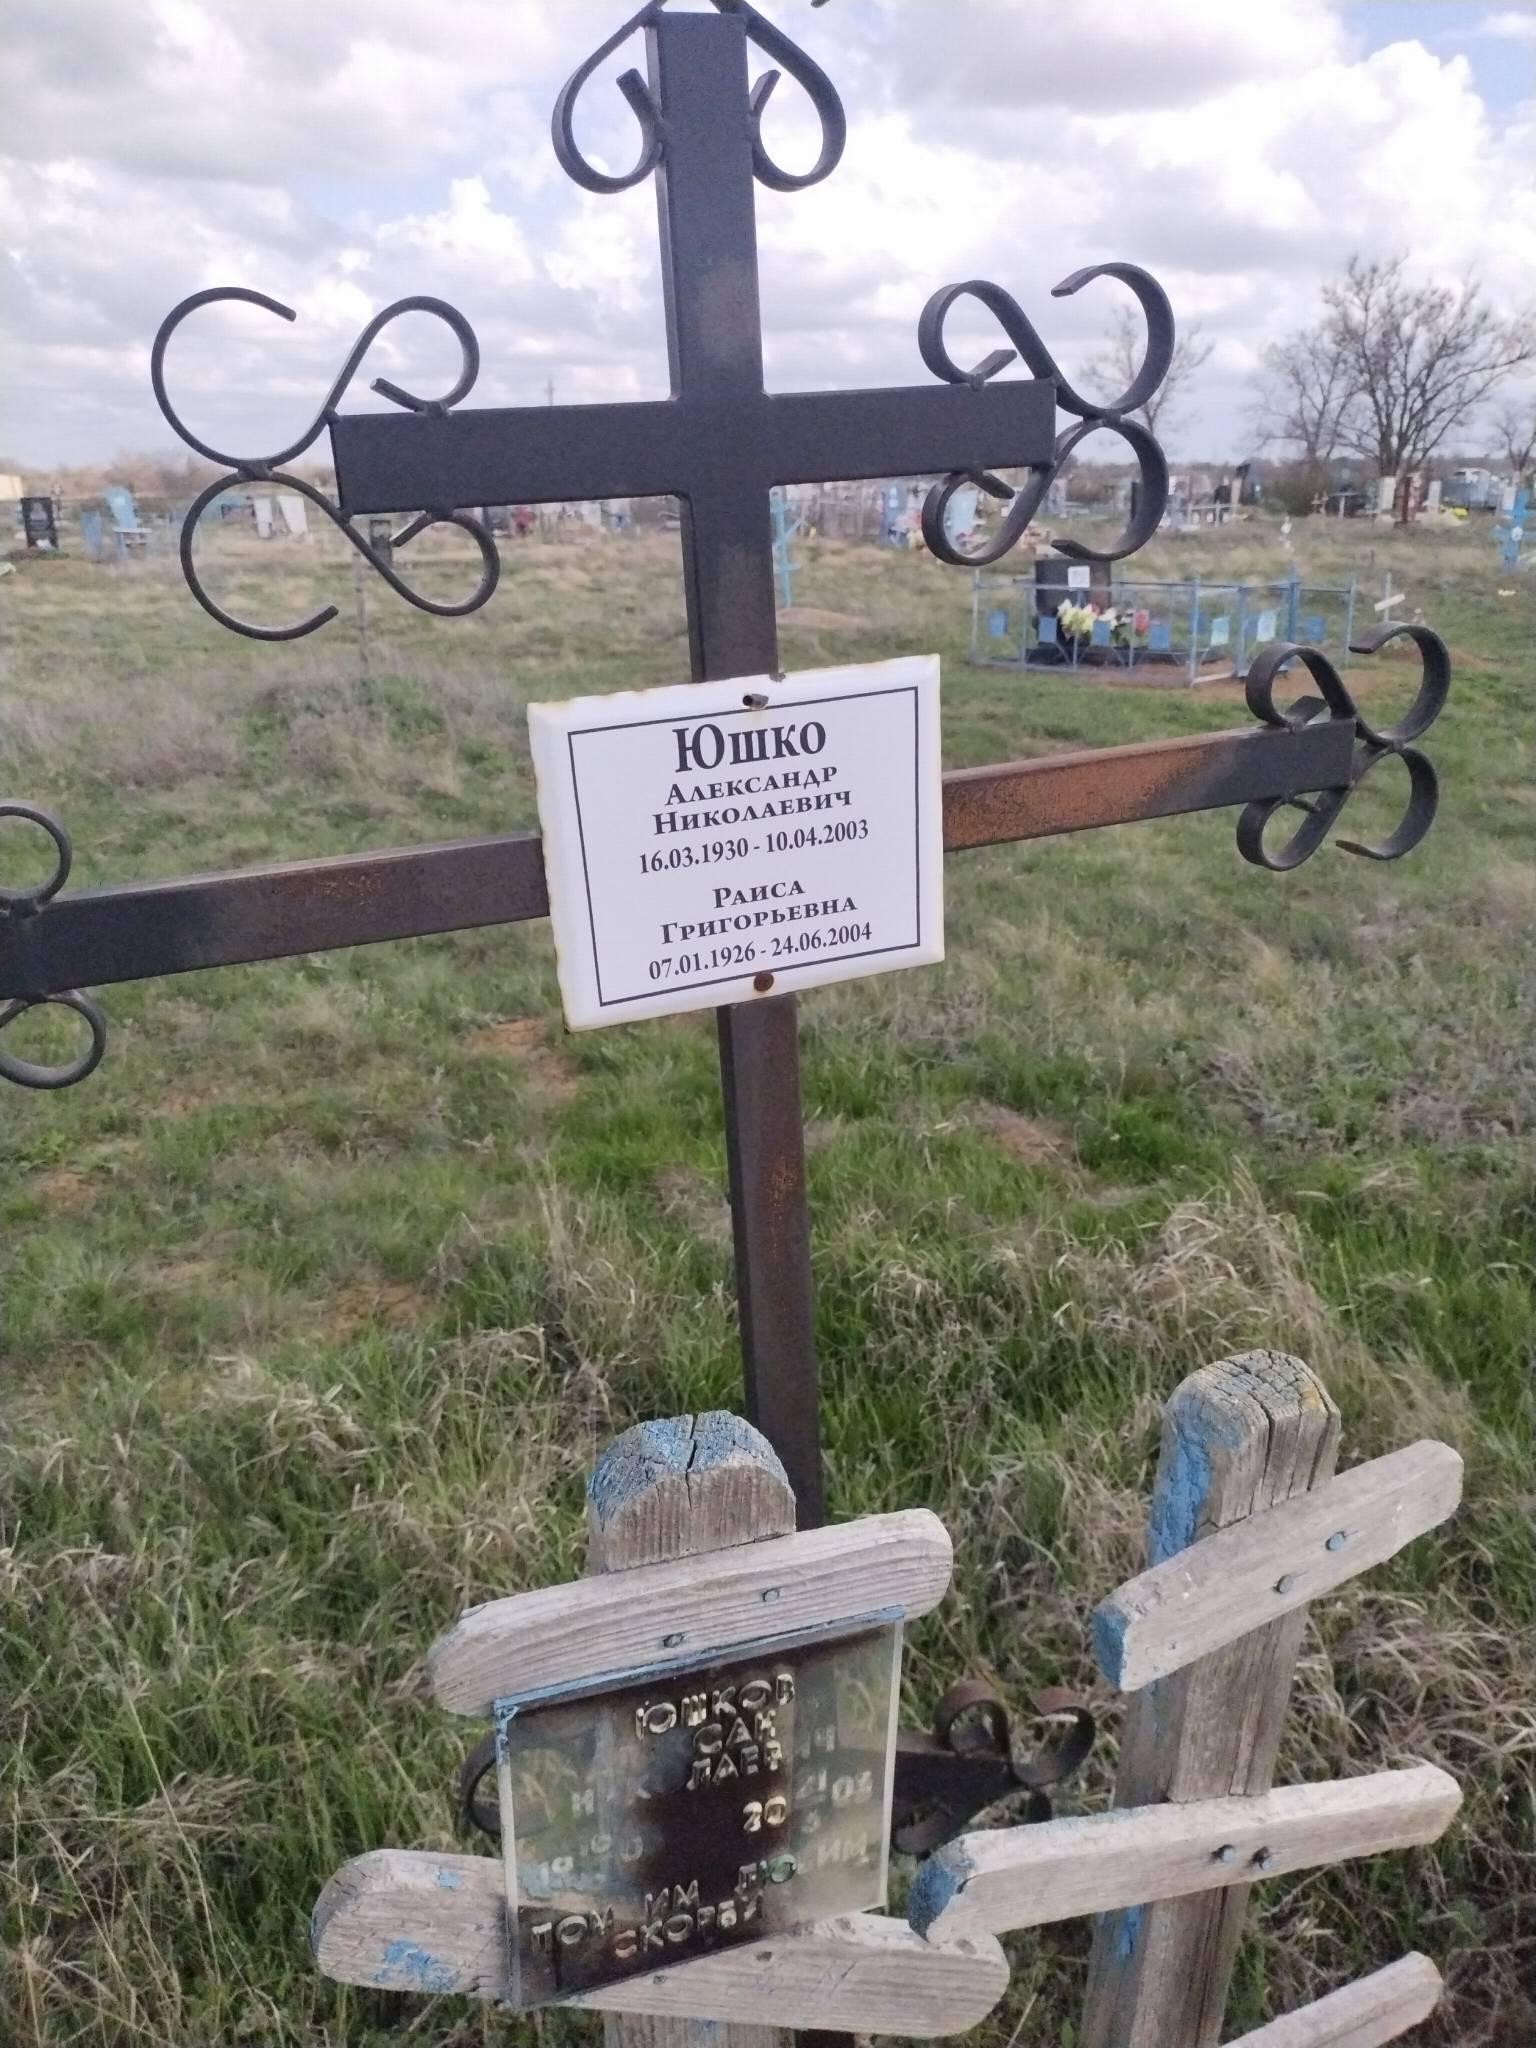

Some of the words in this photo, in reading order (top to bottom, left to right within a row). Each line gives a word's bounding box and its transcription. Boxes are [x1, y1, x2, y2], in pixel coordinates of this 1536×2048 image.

[640, 838, 749, 873] 16.03.1930
[766, 819, 869, 853] 10.04.2003
[649, 941, 756, 980] 07.01.1926
[771, 922, 872, 957] 24.06.2004
